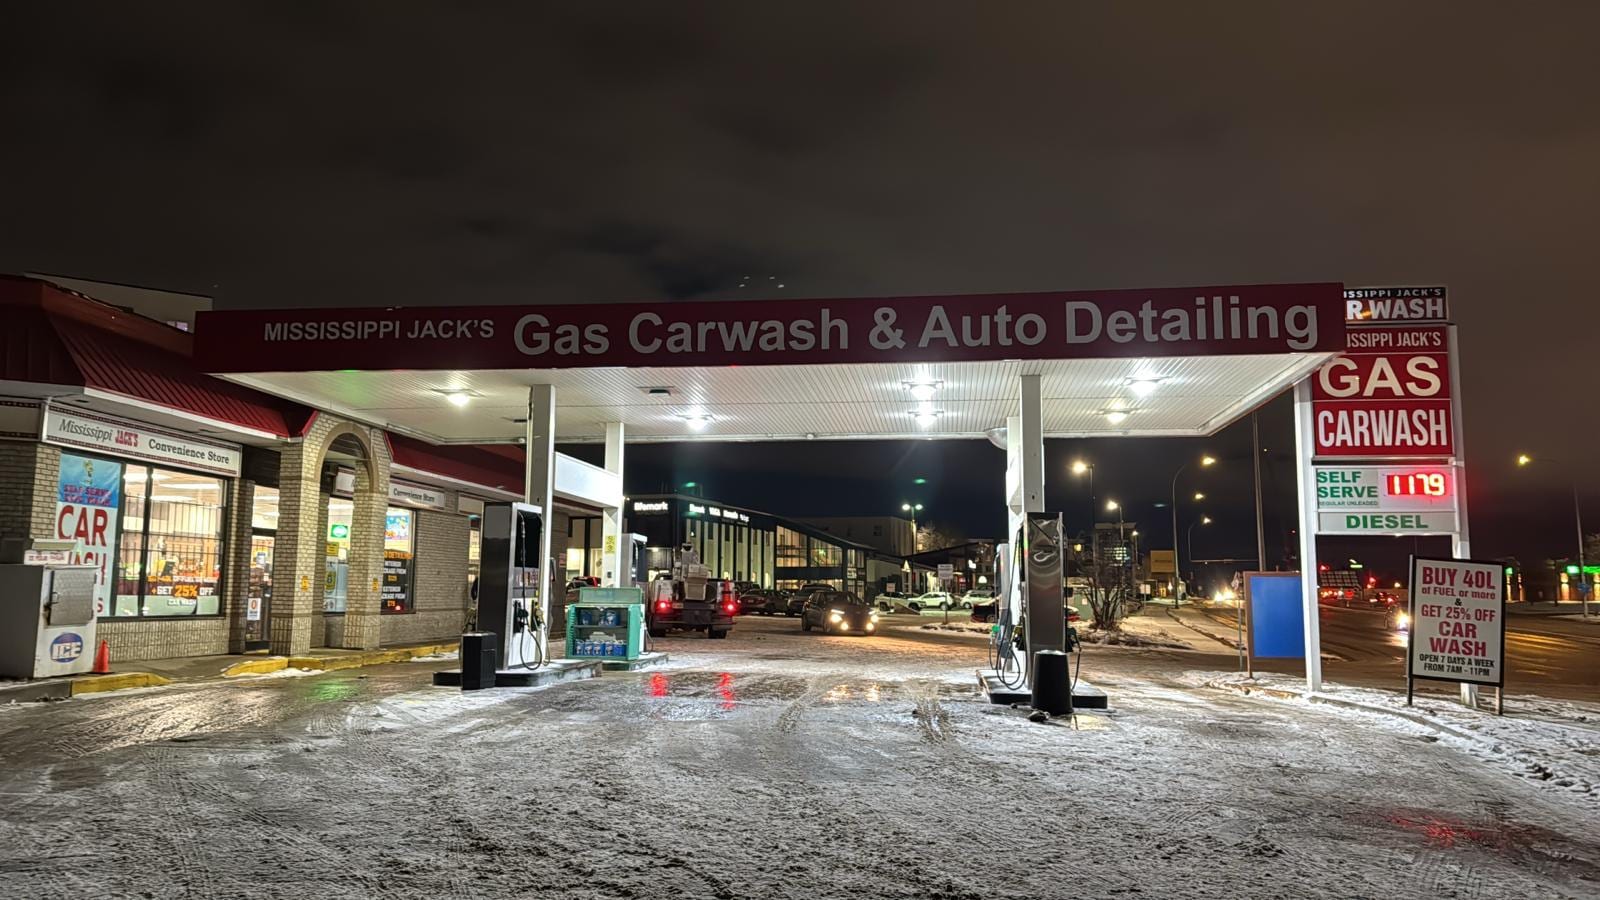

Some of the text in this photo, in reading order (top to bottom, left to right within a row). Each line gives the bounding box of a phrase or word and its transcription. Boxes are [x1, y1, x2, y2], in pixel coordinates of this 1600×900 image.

[1344, 288, 1441, 298] ISSIPPI JACK'S
[1368, 298, 1444, 320] WASH
[264, 319, 495, 342] MISSISSIPPI JACK'S
[513, 296, 1319, 356] Gas Carwash & Auto Detailing
[1346, 331, 1442, 348] ISSIPPI JACK'S
[1319, 356, 1441, 398] GAS
[58, 418, 139, 447] Mississippi JACK'S
[1318, 409, 1448, 447] CARWASH
[148, 438, 231, 465] Convenience Store
[1317, 471, 1362, 483] SELF
[1317, 486, 1379, 498] SERVE
[57, 505, 108, 547] CAR
[1346, 515, 1429, 529] DIESEL
[1422, 567, 1496, 590] BUY 40L
[174, 584, 198, 598] 25%
[199, 587, 215, 596] OFF
[1421, 586, 1496, 600] of FUEL or more
[1454, 598, 1463, 607] &
[1421, 604, 1496, 622] GET 25% OFF
[1438, 621, 1477, 638] CAR
[51, 641, 82, 661] ICE
[1429, 638, 1487, 656] WASH
[1419, 653, 1439, 662] OPEN
[1447, 656, 1466, 666] DAYS
[1474, 659, 1495, 668] WEEK
[1423, 663, 1444, 672] FROM
[1446, 664, 1463, 673] 7AM
[1470, 667, 1490, 677] 11PM
